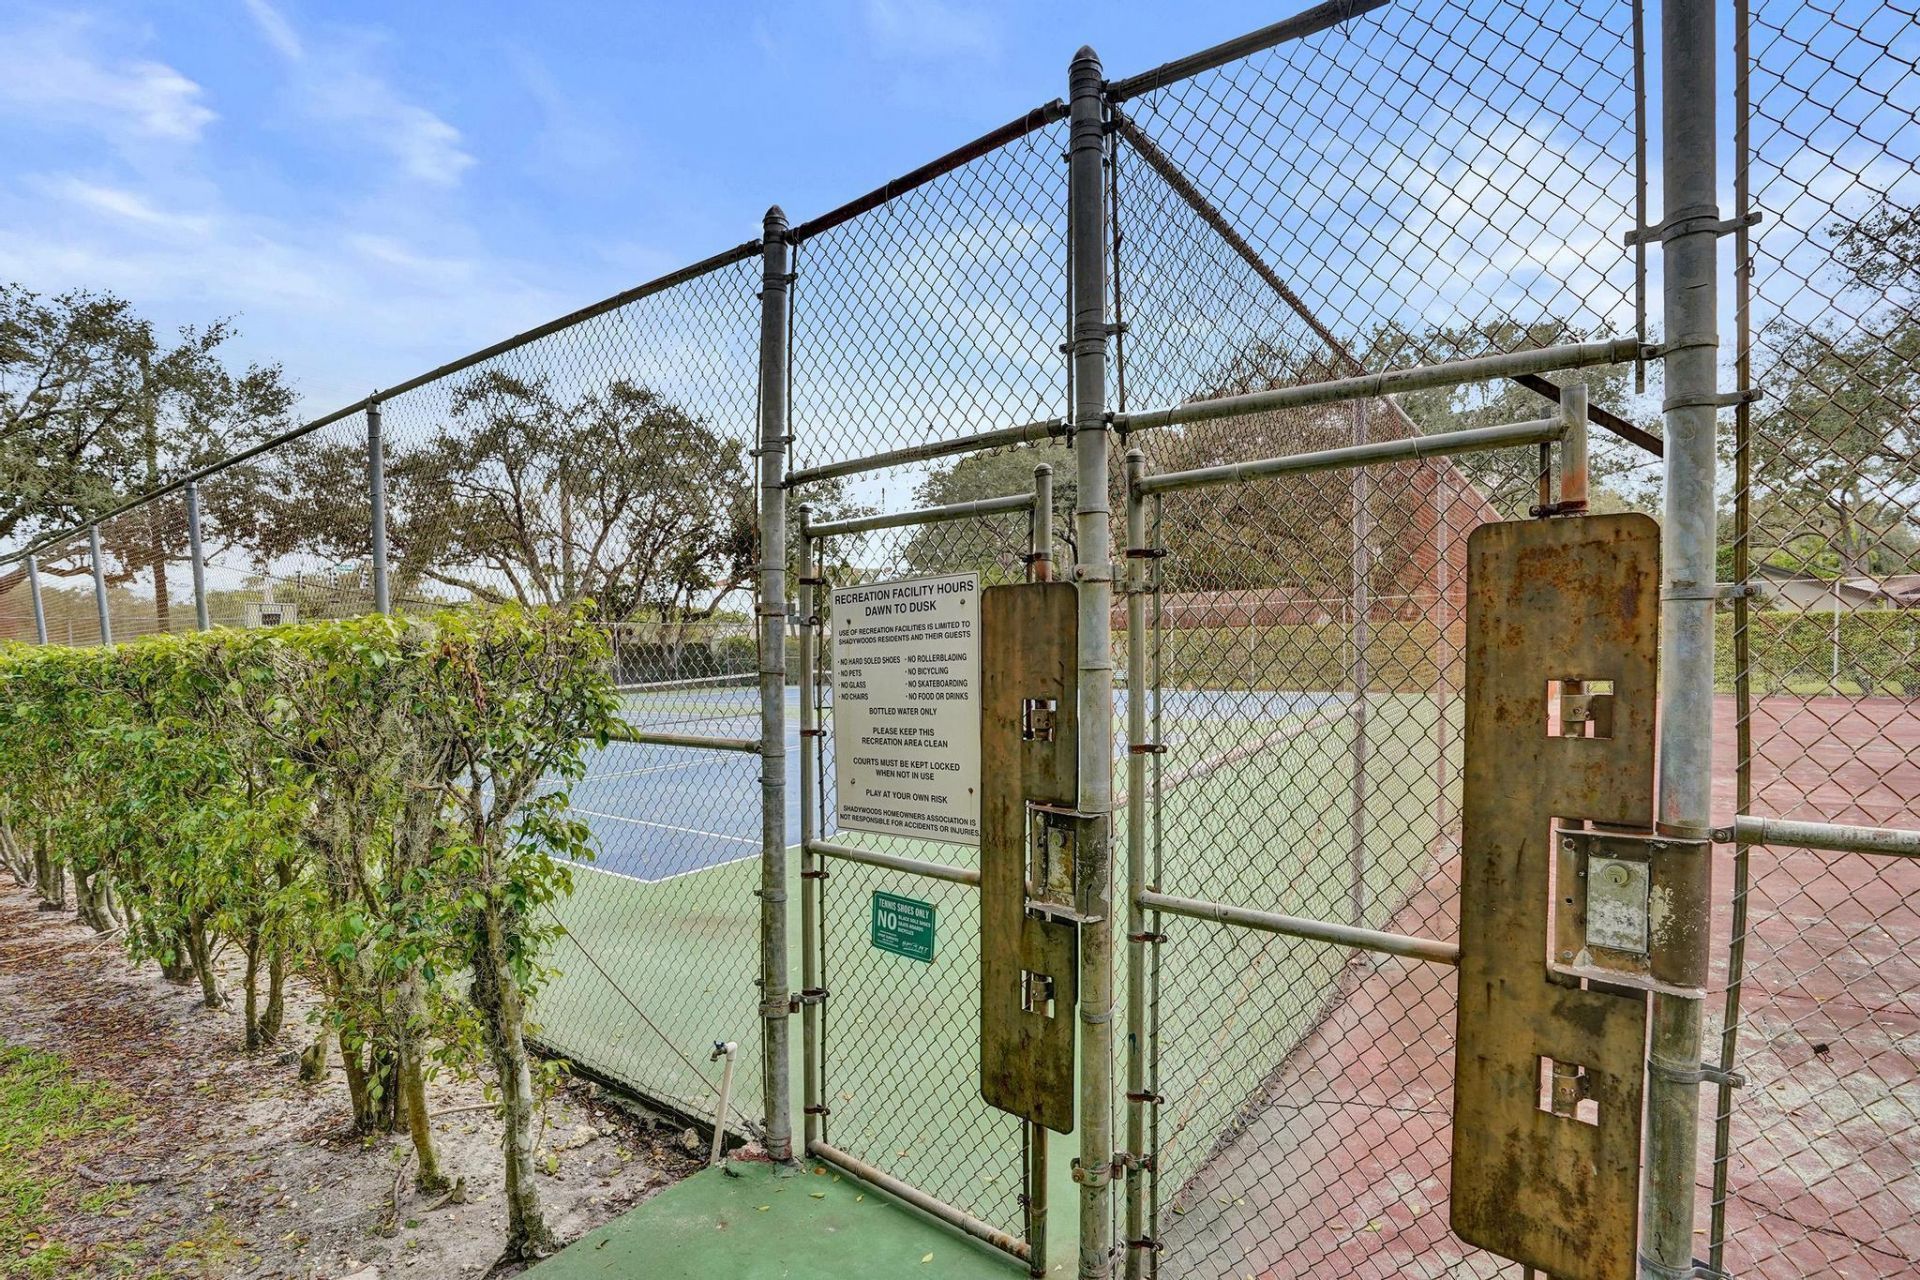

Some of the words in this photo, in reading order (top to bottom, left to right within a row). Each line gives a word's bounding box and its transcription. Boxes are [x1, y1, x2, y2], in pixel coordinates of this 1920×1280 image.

[835, 590, 890, 604] RECREATION
[893, 585, 934, 598] FACILITY
[937, 580, 974, 594] HOURS
[865, 604, 892, 616] DAWN
[894, 603, 907, 613] TO
[910, 600, 936, 612] DUSK
[859, 626, 893, 635] RECREATION
[895, 624, 926, 633] FACILITIES
[839, 636, 876, 645] SHADYWOODS
[878, 634, 909, 643] RESIDENTS
[917, 653, 966, 662] ROLLERBLADING
[918, 679, 968, 687] SKATEBOARDING
[862, 738, 902, 746] RECREATION
[853, 757, 879, 766] COURTS
[930, 762, 960, 771] LOCKED
[876, 770, 895, 778] WHEN
[866, 789, 882, 797] PLAY
[893, 792, 911, 800] YOUR
[913, 793, 929, 802] OWN
[931, 795, 948, 804] RISK
[844, 805, 882, 816] SHADYWOODS
[883, 810, 925, 820] HOMEOWNERS
[927, 815, 968, 825] ASSOCIATION
[852, 815, 890, 826] RESPONSIBLE
[904, 821, 938, 831] ACCIDENTS
[879, 898, 896, 911] TENNIS
[915, 908, 929, 919] ONLY
[878, 909, 897, 930] NO
